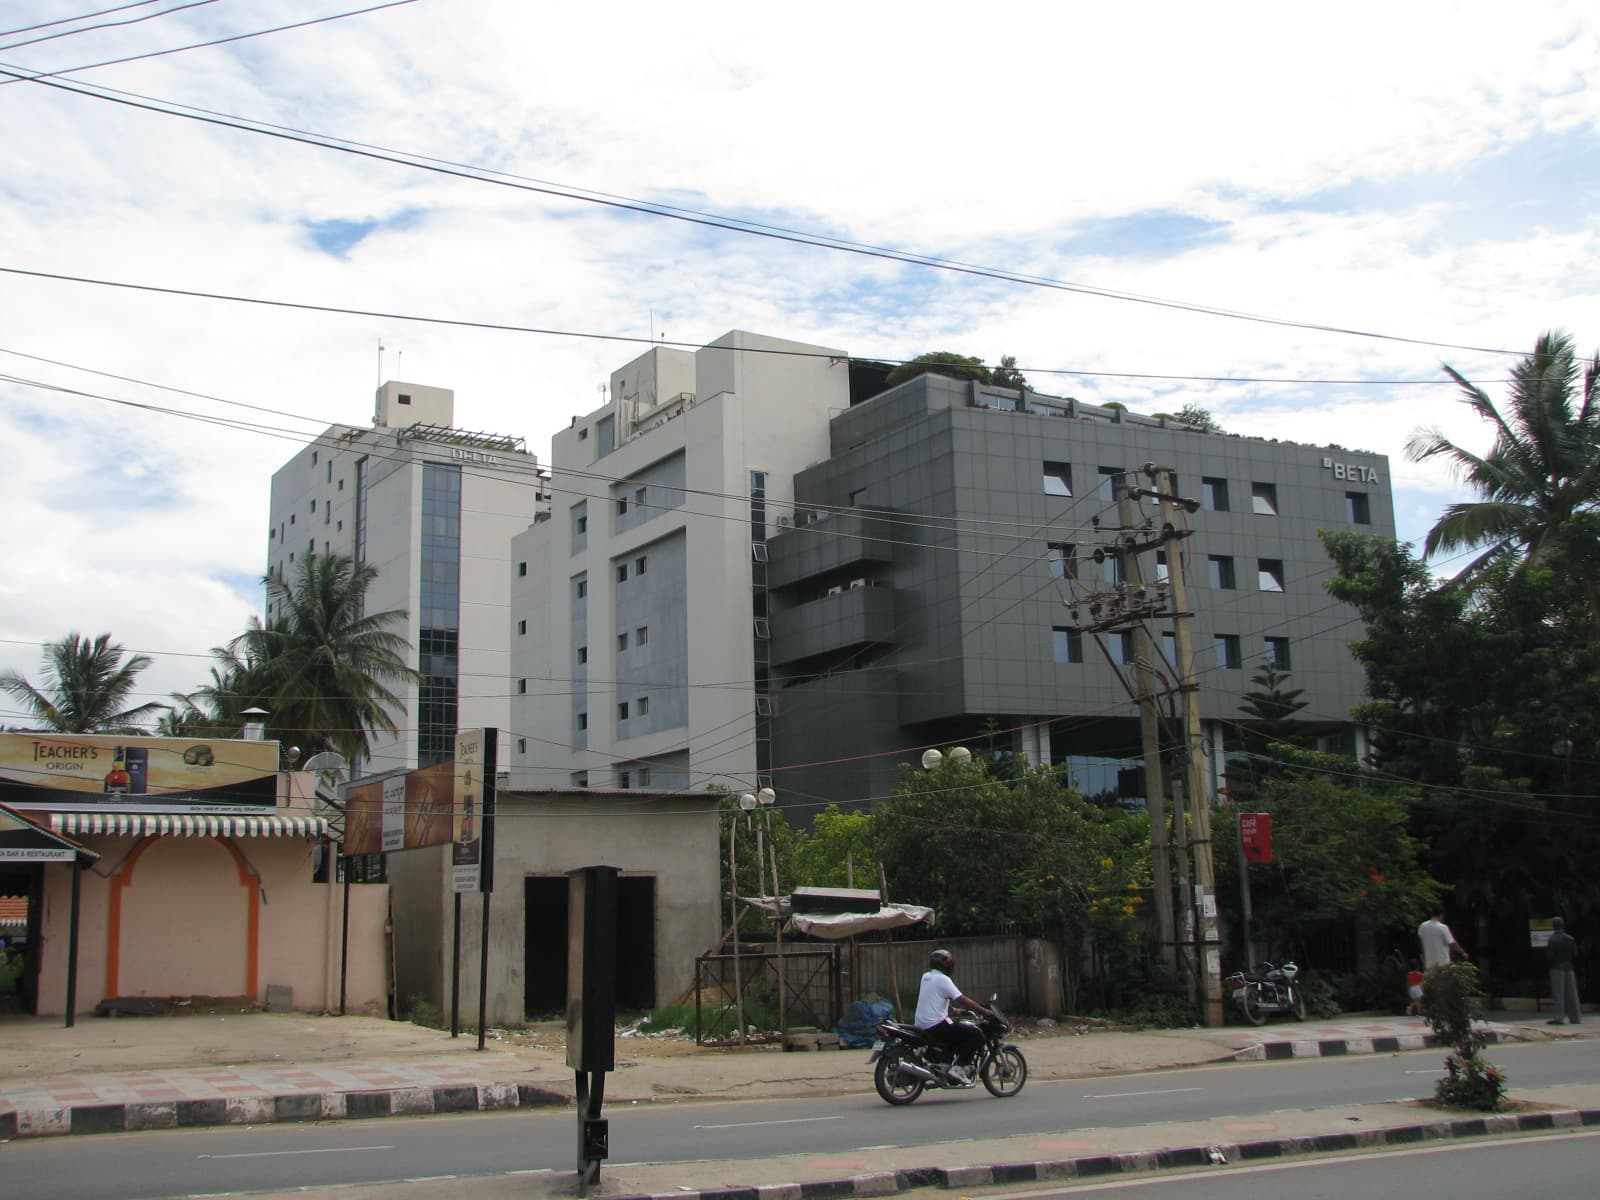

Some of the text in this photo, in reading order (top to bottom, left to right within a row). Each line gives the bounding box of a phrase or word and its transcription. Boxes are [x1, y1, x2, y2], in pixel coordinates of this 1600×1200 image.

[1334, 463, 1378, 484] BETA
[32, 741, 98, 762] TEACHER'S
[46, 762, 84, 771] ORIGIN
